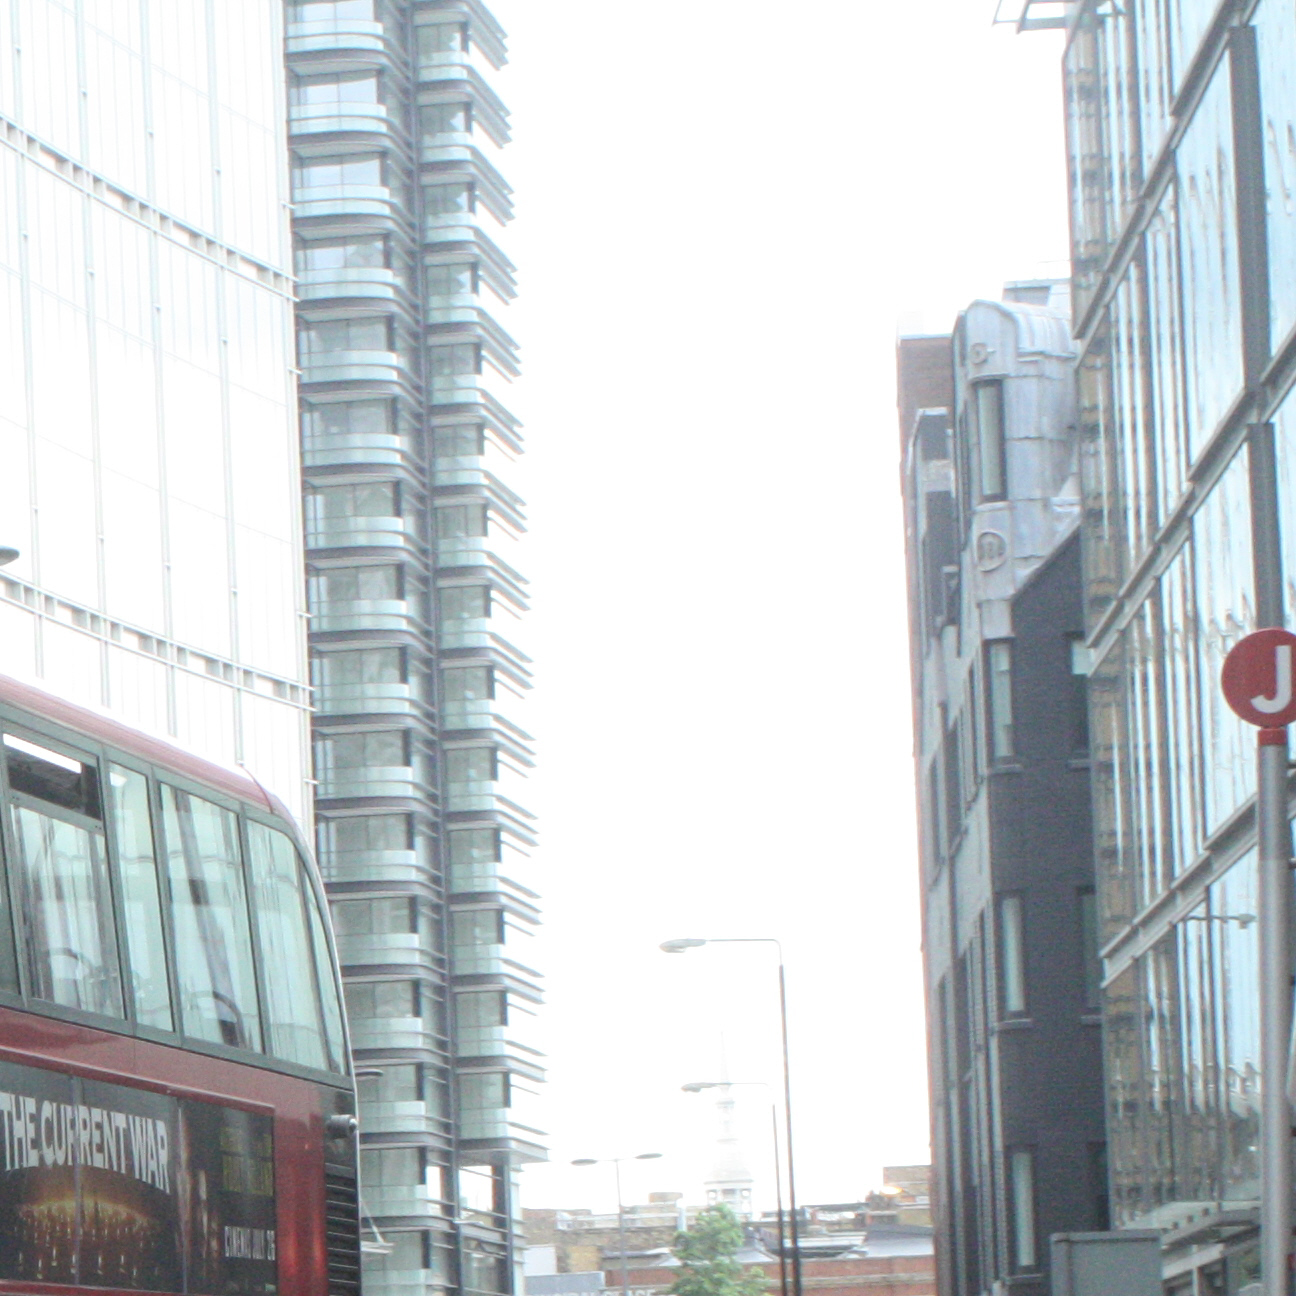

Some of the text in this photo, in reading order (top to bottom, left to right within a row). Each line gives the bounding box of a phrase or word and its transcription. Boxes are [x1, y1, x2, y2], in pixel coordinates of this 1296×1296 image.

[1250, 645, 1292, 714] J
[40, 1100, 127, 1174] CURRENT
[129, 1114, 170, 1194] WAR
